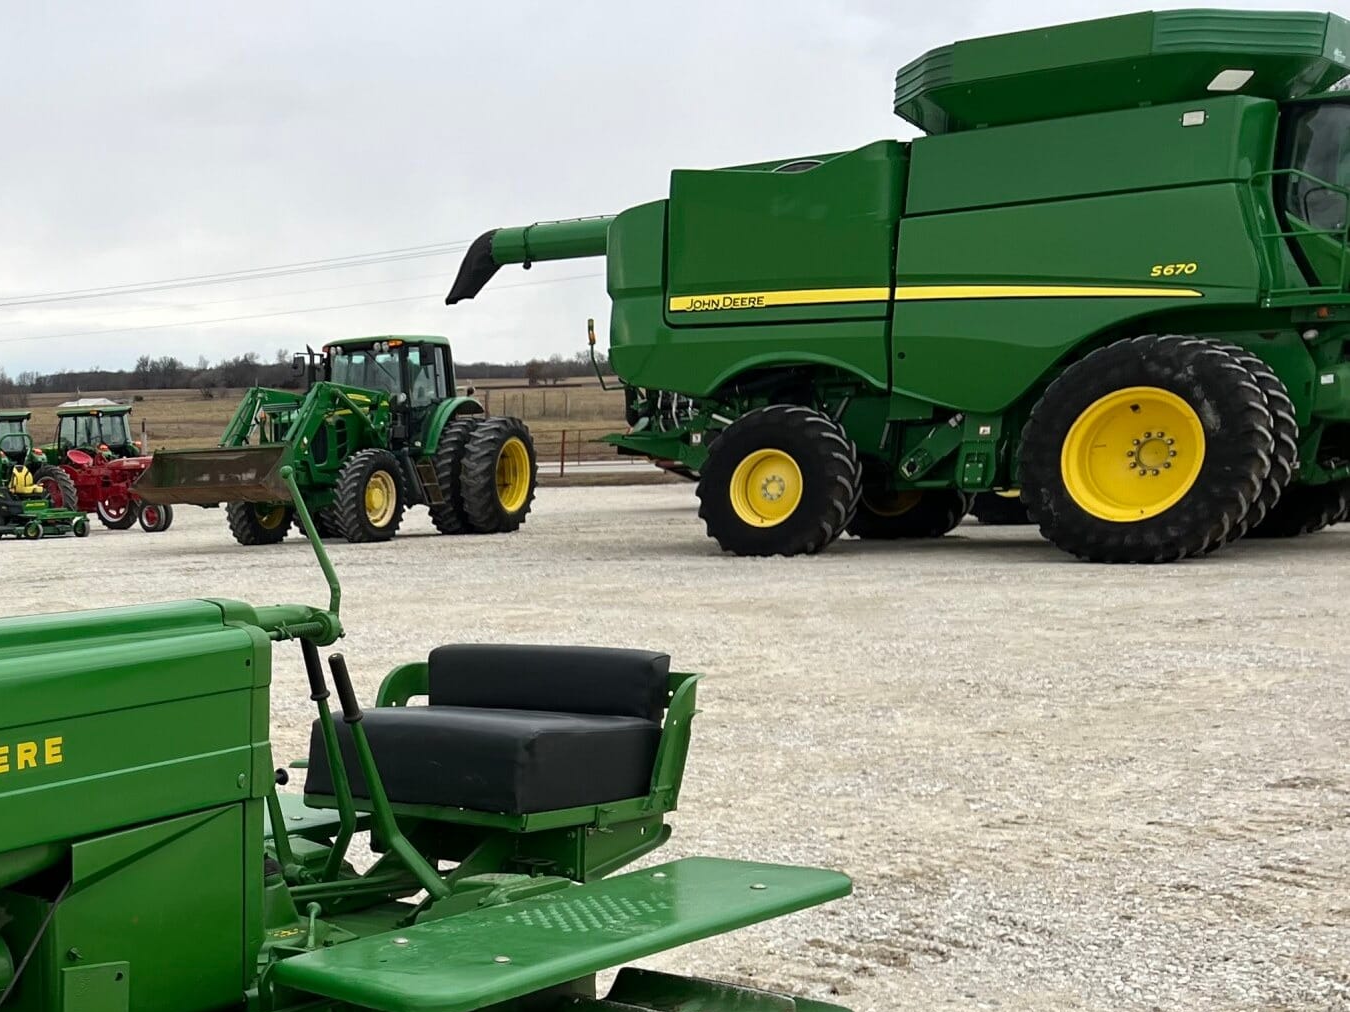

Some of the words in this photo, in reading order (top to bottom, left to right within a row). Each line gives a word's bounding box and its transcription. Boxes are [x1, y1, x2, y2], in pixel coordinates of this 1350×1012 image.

[1150, 263, 1197, 277] S670
[686, 298, 720, 310] JOHN
[722, 296, 765, 308] DEERE
